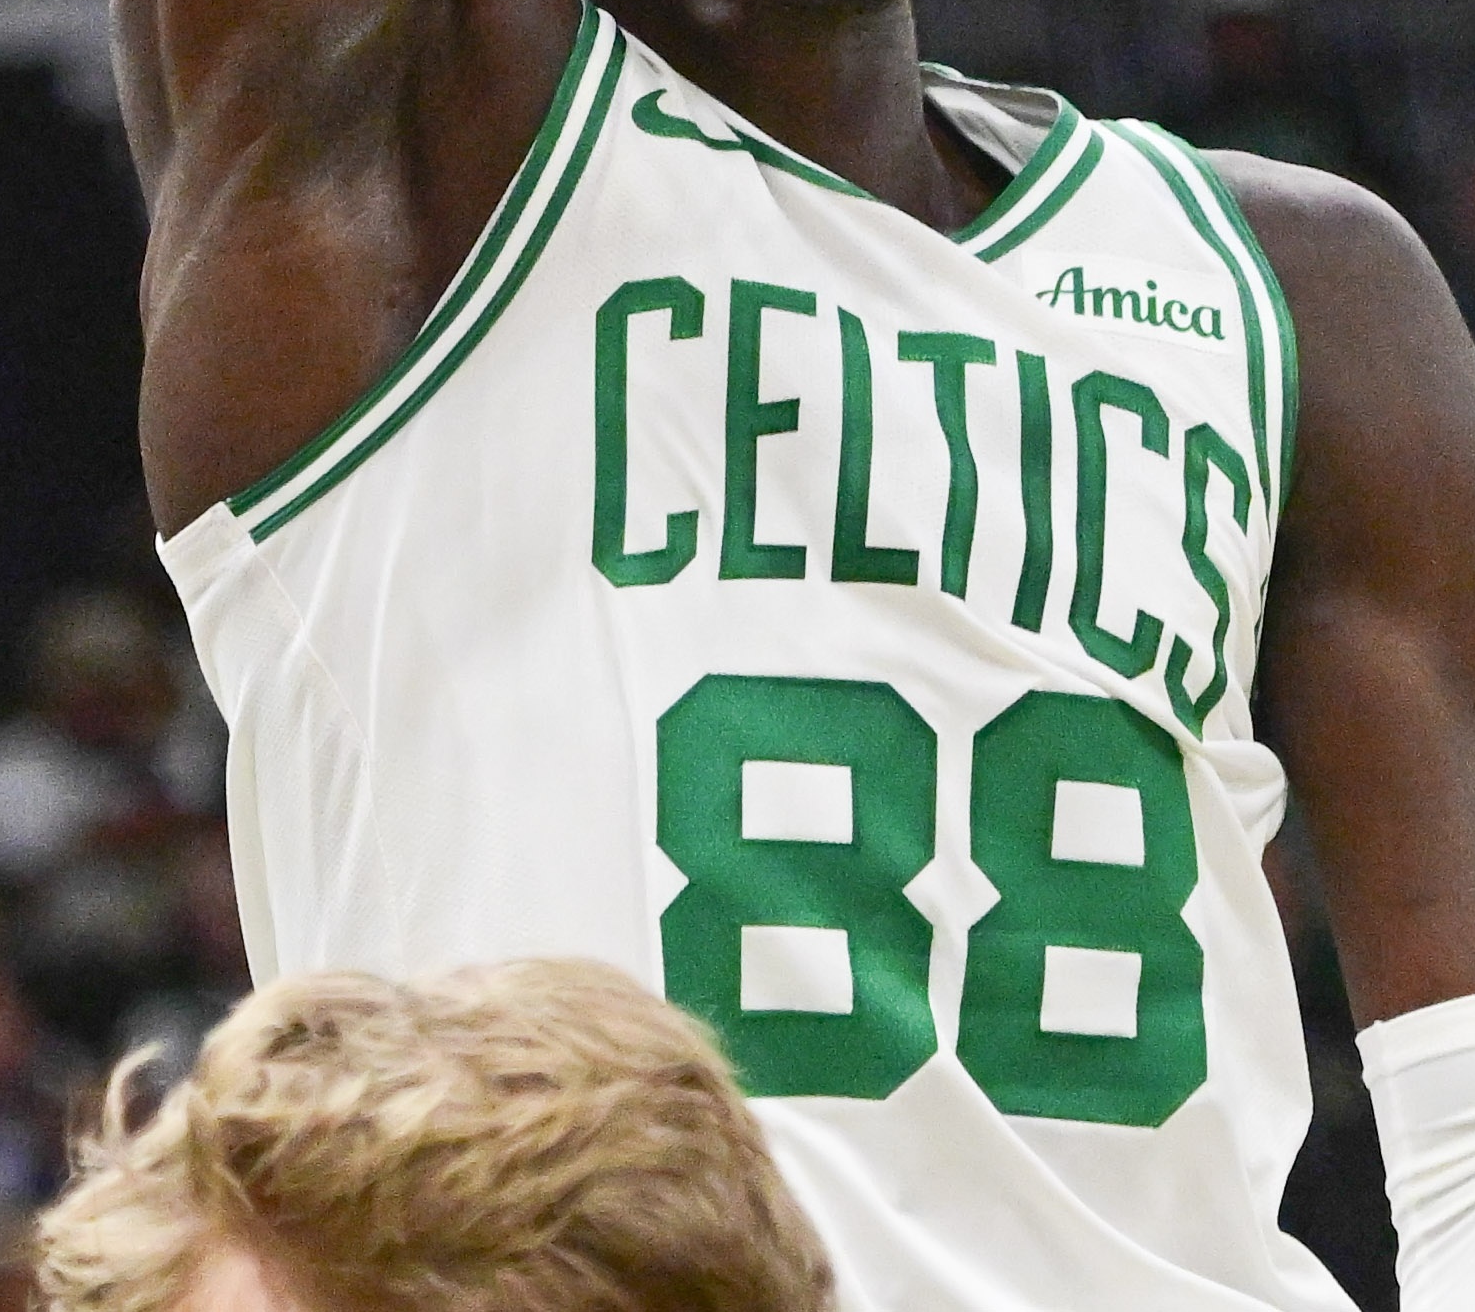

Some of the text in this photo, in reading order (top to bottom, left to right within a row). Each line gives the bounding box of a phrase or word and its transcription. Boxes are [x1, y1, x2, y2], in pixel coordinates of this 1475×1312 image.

[591, 275, 1253, 743] CELTICS
[1036, 267, 1225, 340] Amica
[656, 673, 1206, 1129] 88
